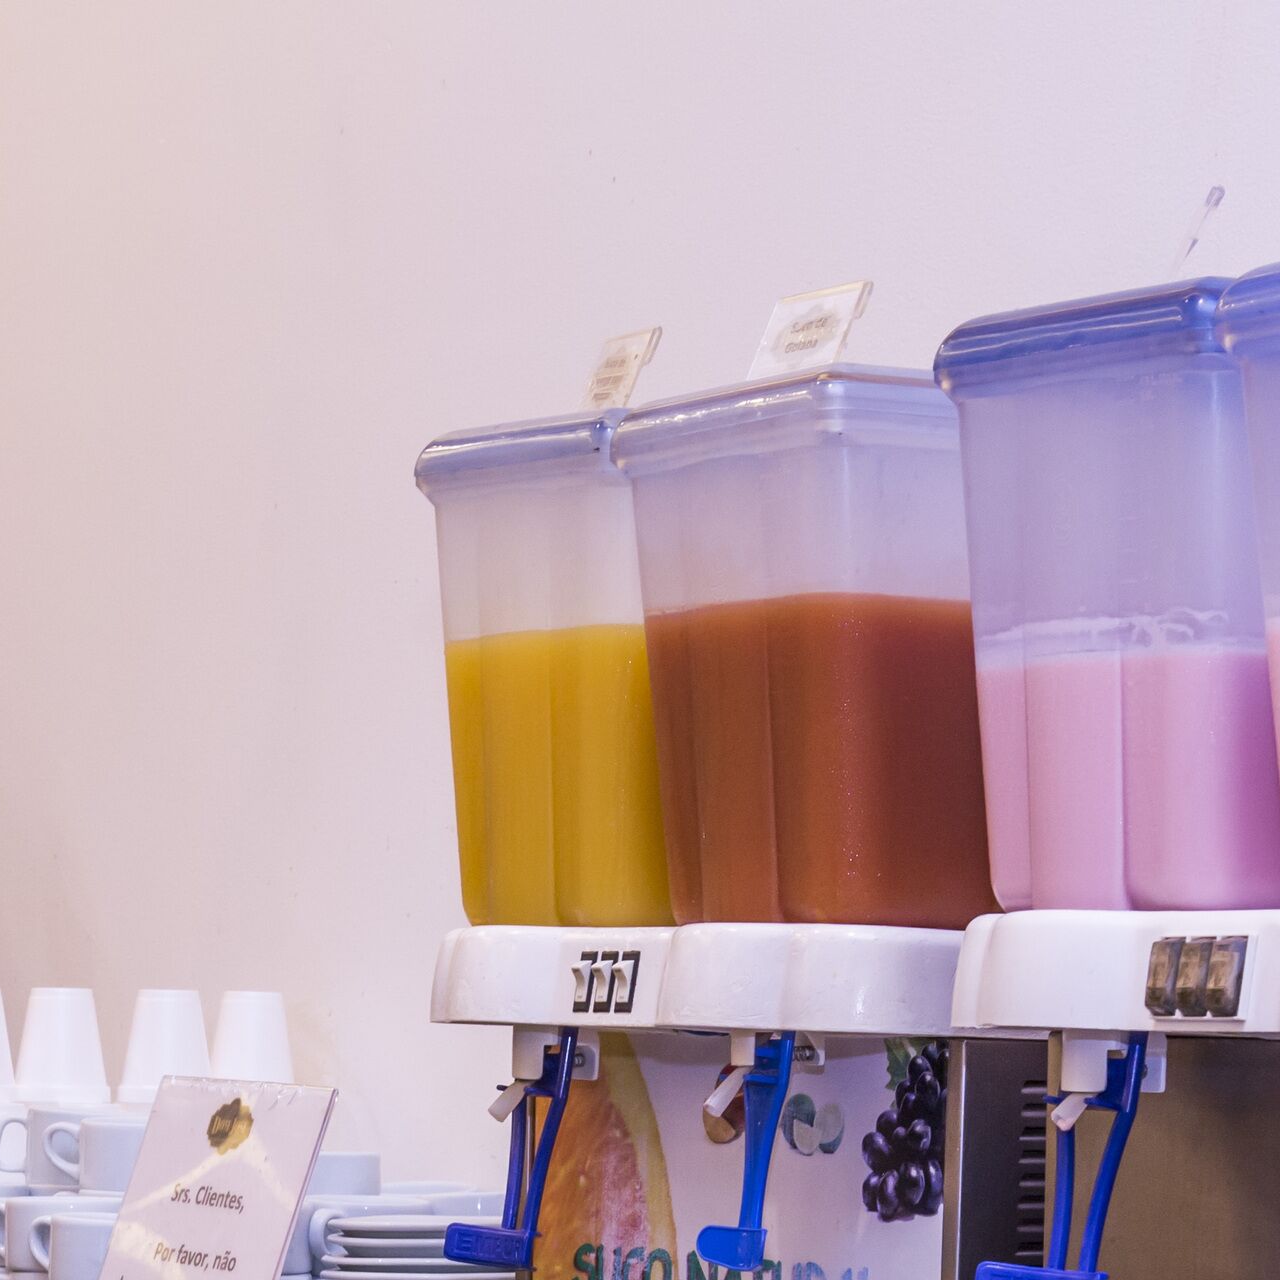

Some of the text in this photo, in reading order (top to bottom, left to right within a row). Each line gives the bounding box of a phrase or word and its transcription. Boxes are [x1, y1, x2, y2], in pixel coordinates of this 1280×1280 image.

[171, 1183, 245, 1215] Srs. Clientes,
[153, 1242, 237, 1272] Por favor, não
